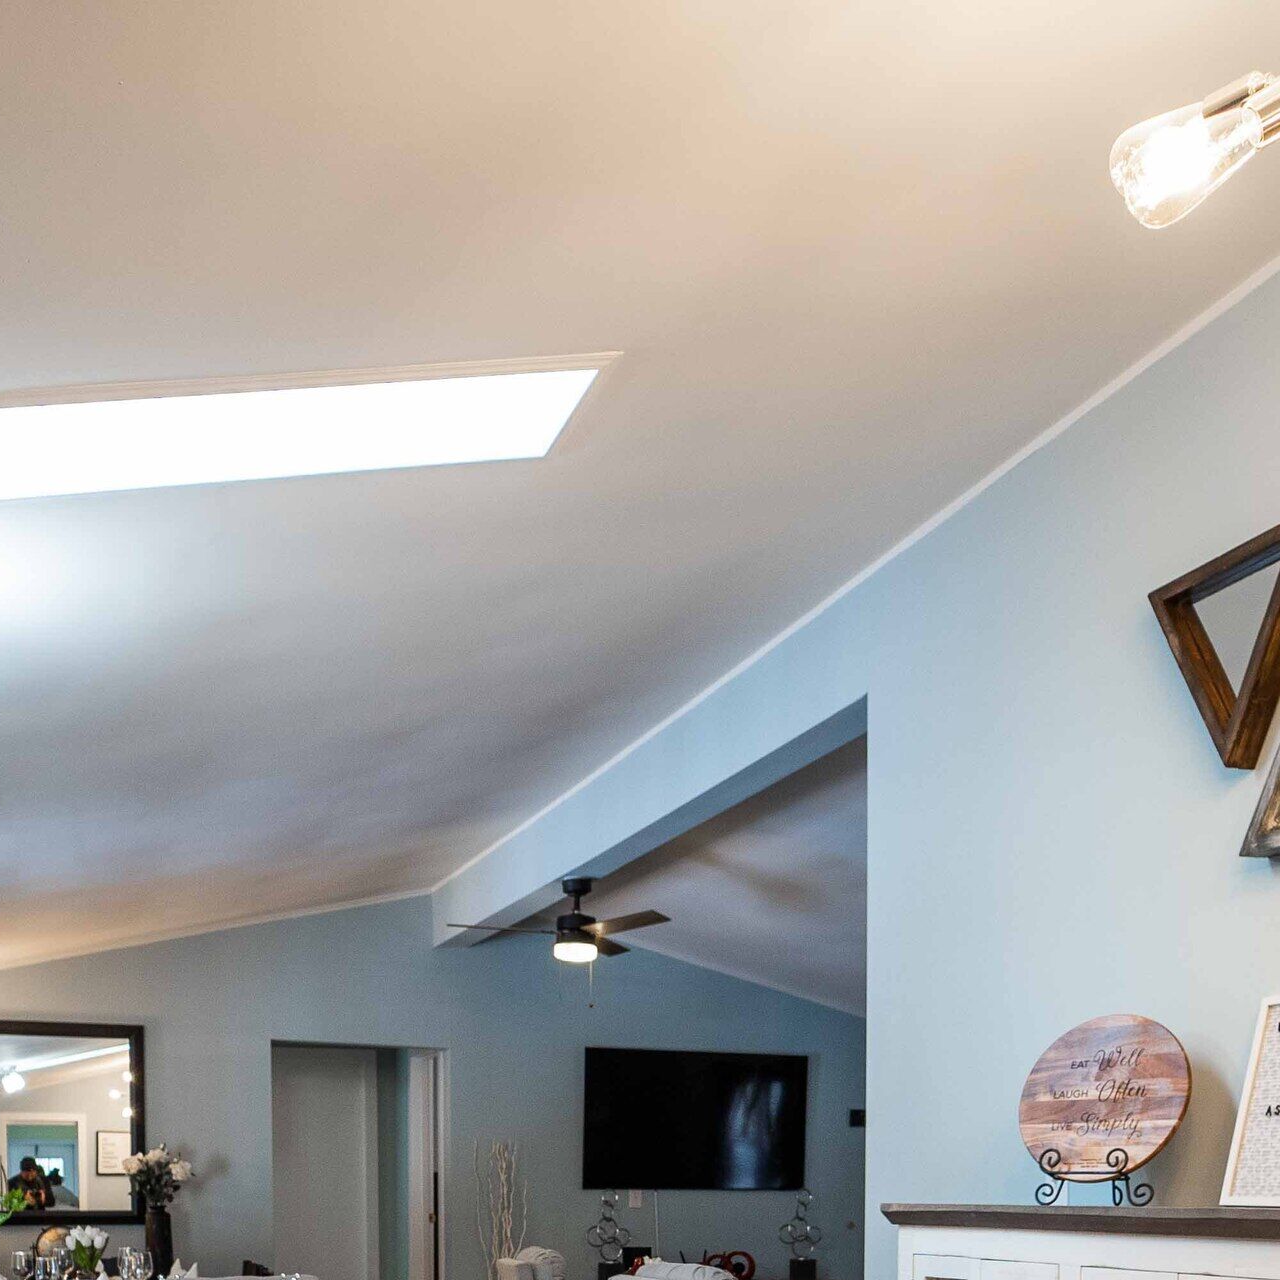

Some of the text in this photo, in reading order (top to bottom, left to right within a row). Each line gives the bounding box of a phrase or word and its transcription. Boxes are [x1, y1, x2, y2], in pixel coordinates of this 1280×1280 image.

[1070, 1046, 1146, 1072] EAT Well
[1052, 1078, 1149, 1103] LAUGH Often
[1050, 1110, 1143, 1140] LIVE Simply
